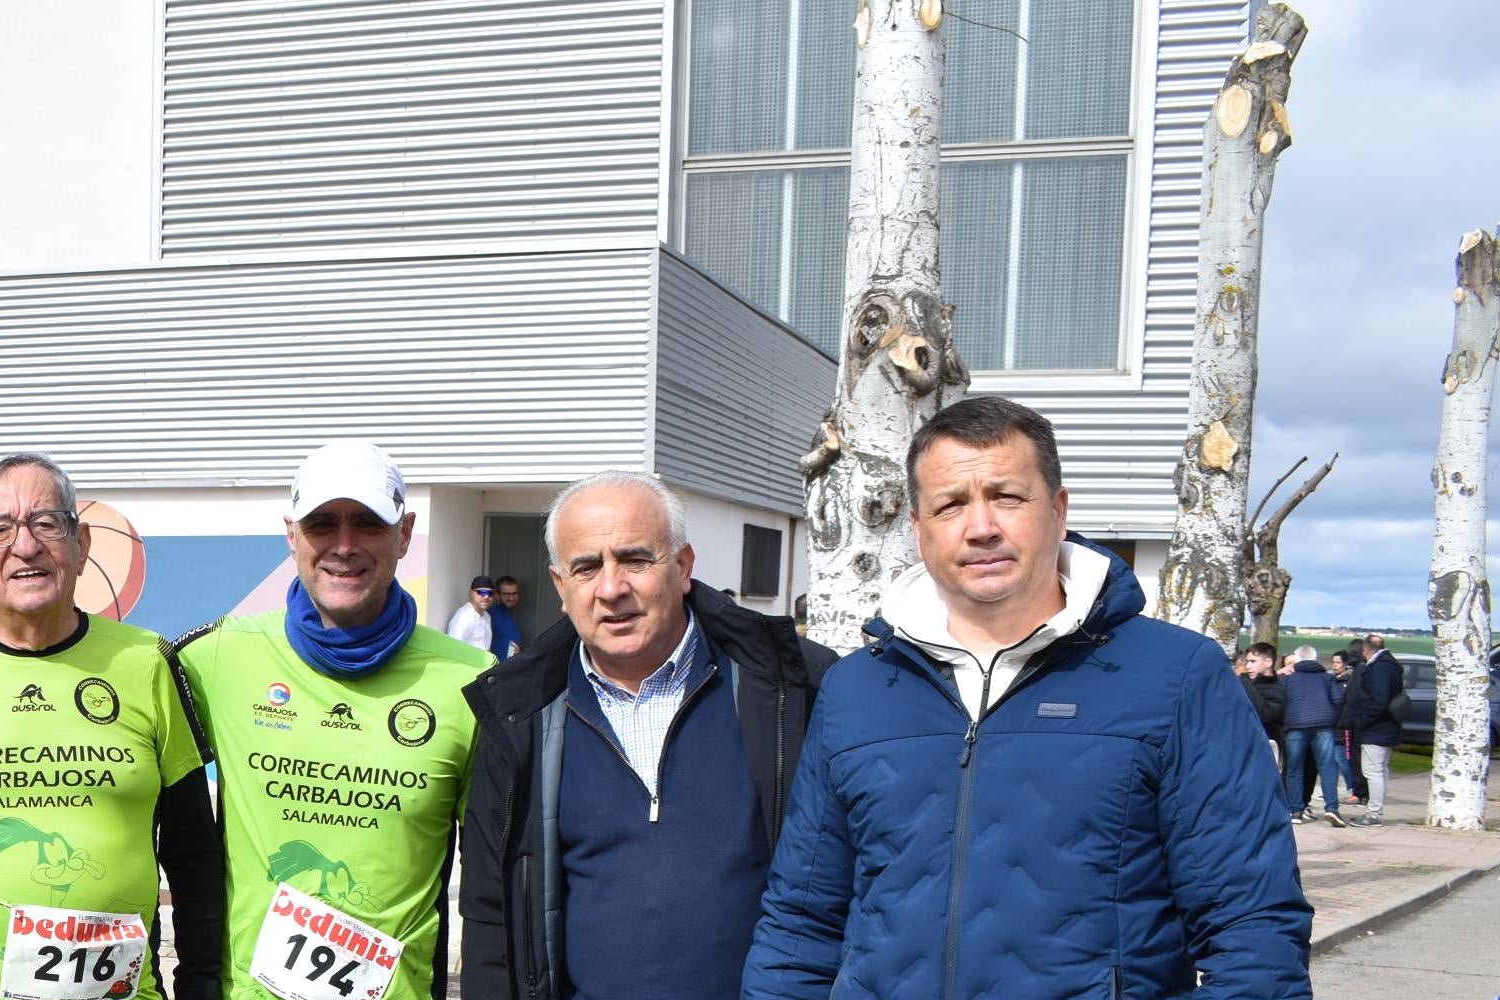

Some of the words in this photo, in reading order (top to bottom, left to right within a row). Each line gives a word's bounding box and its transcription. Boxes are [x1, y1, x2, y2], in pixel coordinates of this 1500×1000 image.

[252, 703, 298, 718] CARBAJOSA
[248, 752, 428, 790] CORRECAMINOS
[265, 780, 402, 811] CARBAJOSA
[282, 809, 379, 829] SALAMANCA
[12, 909, 145, 943] bedunia
[272, 889, 396, 970] bedunia
[34, 945, 116, 984] 216
[284, 933, 361, 998] 194
